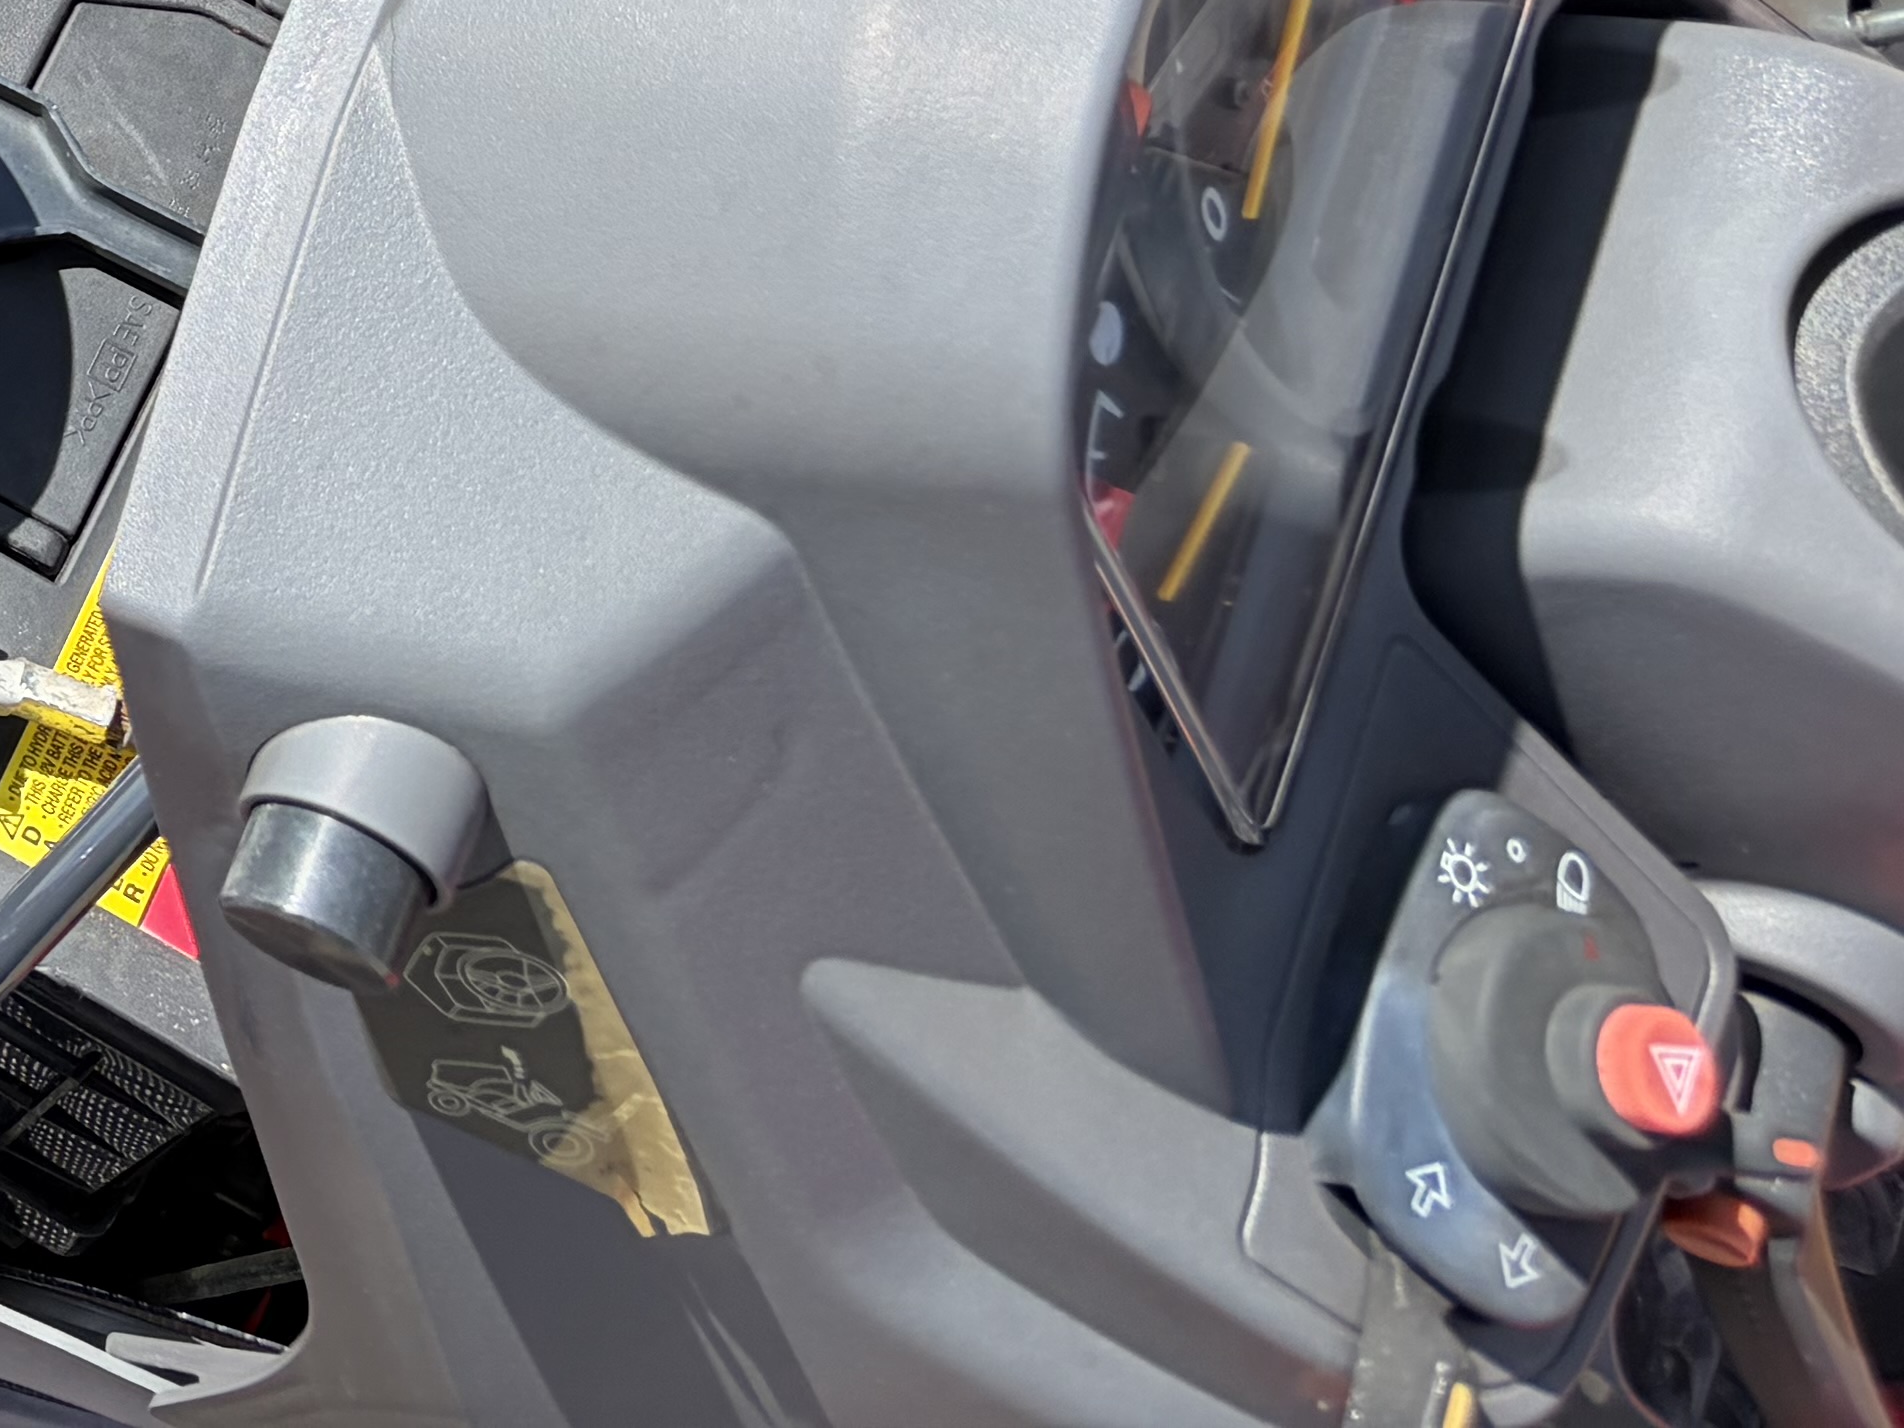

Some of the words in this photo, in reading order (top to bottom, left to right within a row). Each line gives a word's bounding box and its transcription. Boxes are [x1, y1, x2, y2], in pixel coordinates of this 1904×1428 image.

[25, 778, 47, 805] THIS
[46, 729, 73, 761] BATT
[28, 723, 53, 760] HYDR
[61, 741, 86, 769] THIS
[57, 785, 86, 826] REFER
[82, 746, 105, 771] THE
